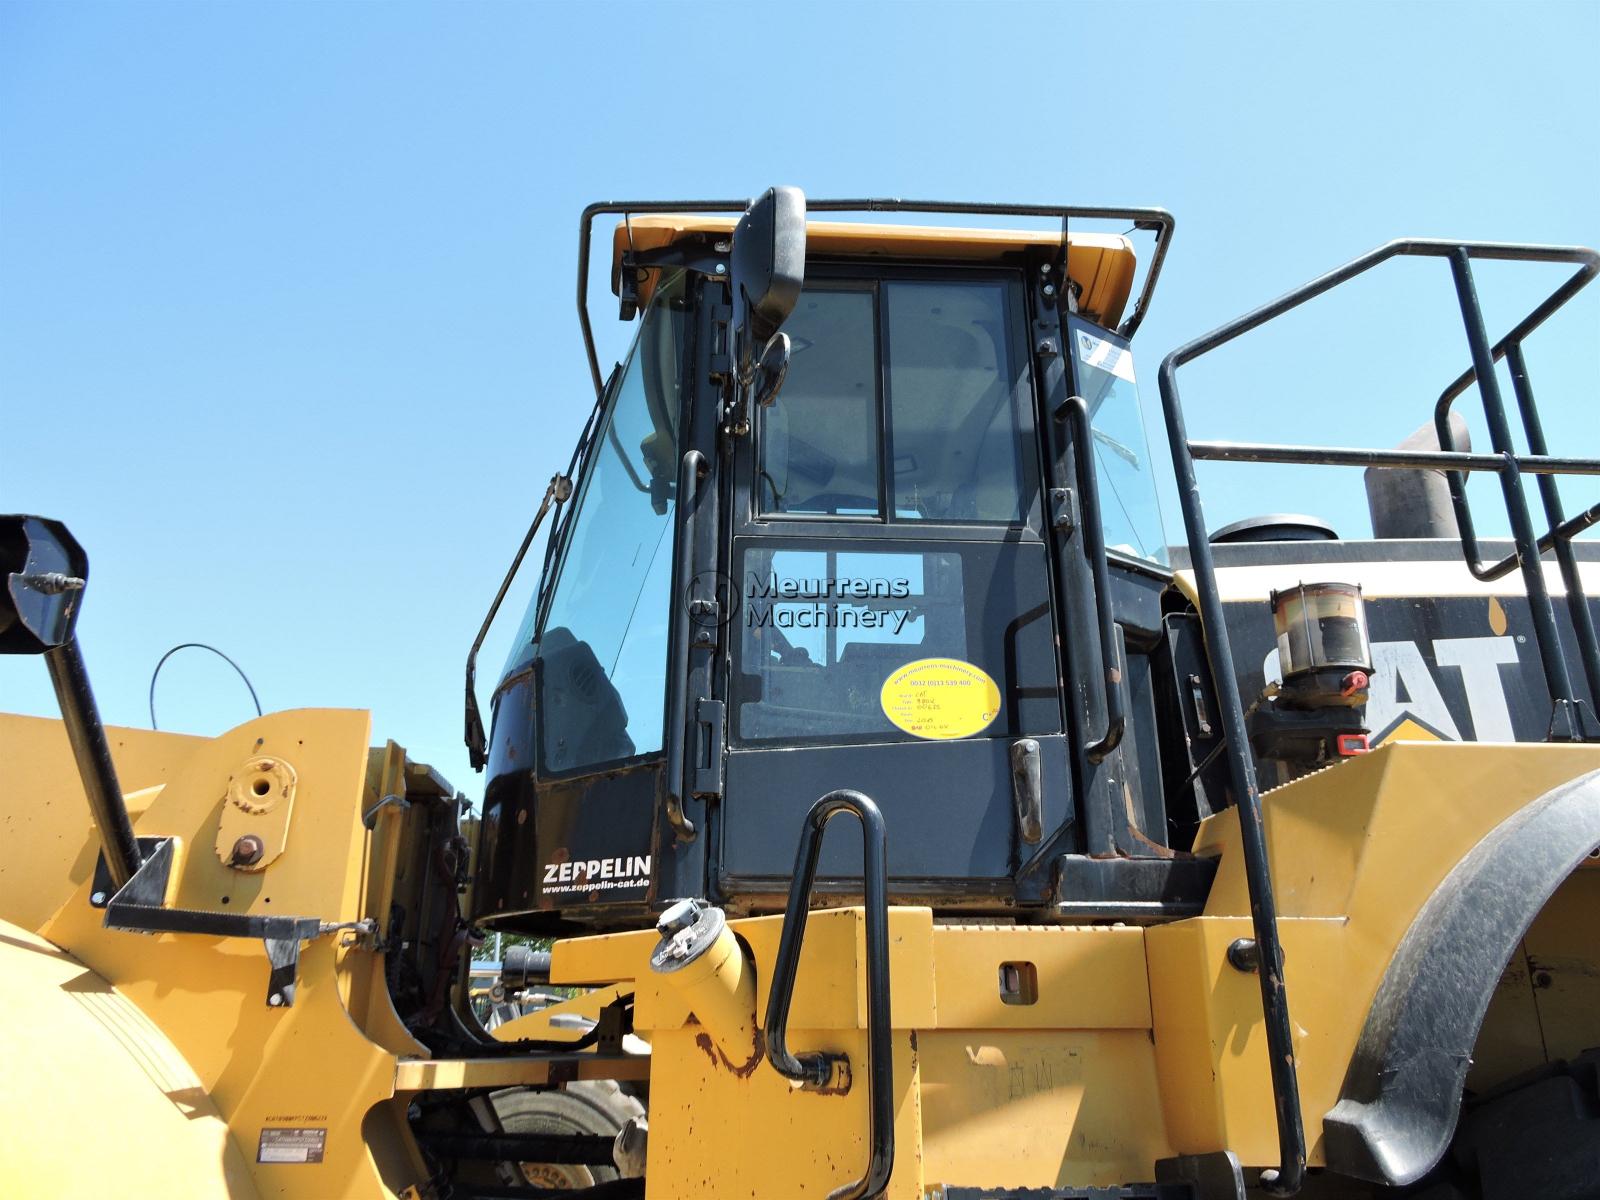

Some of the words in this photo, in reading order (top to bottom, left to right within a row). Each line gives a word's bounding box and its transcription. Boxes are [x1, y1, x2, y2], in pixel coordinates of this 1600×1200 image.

[1263, 636, 1519, 743] AT
[543, 855, 652, 883] ZEPPELIN
[542, 878, 650, 894] www.zeppelin-cat.de
